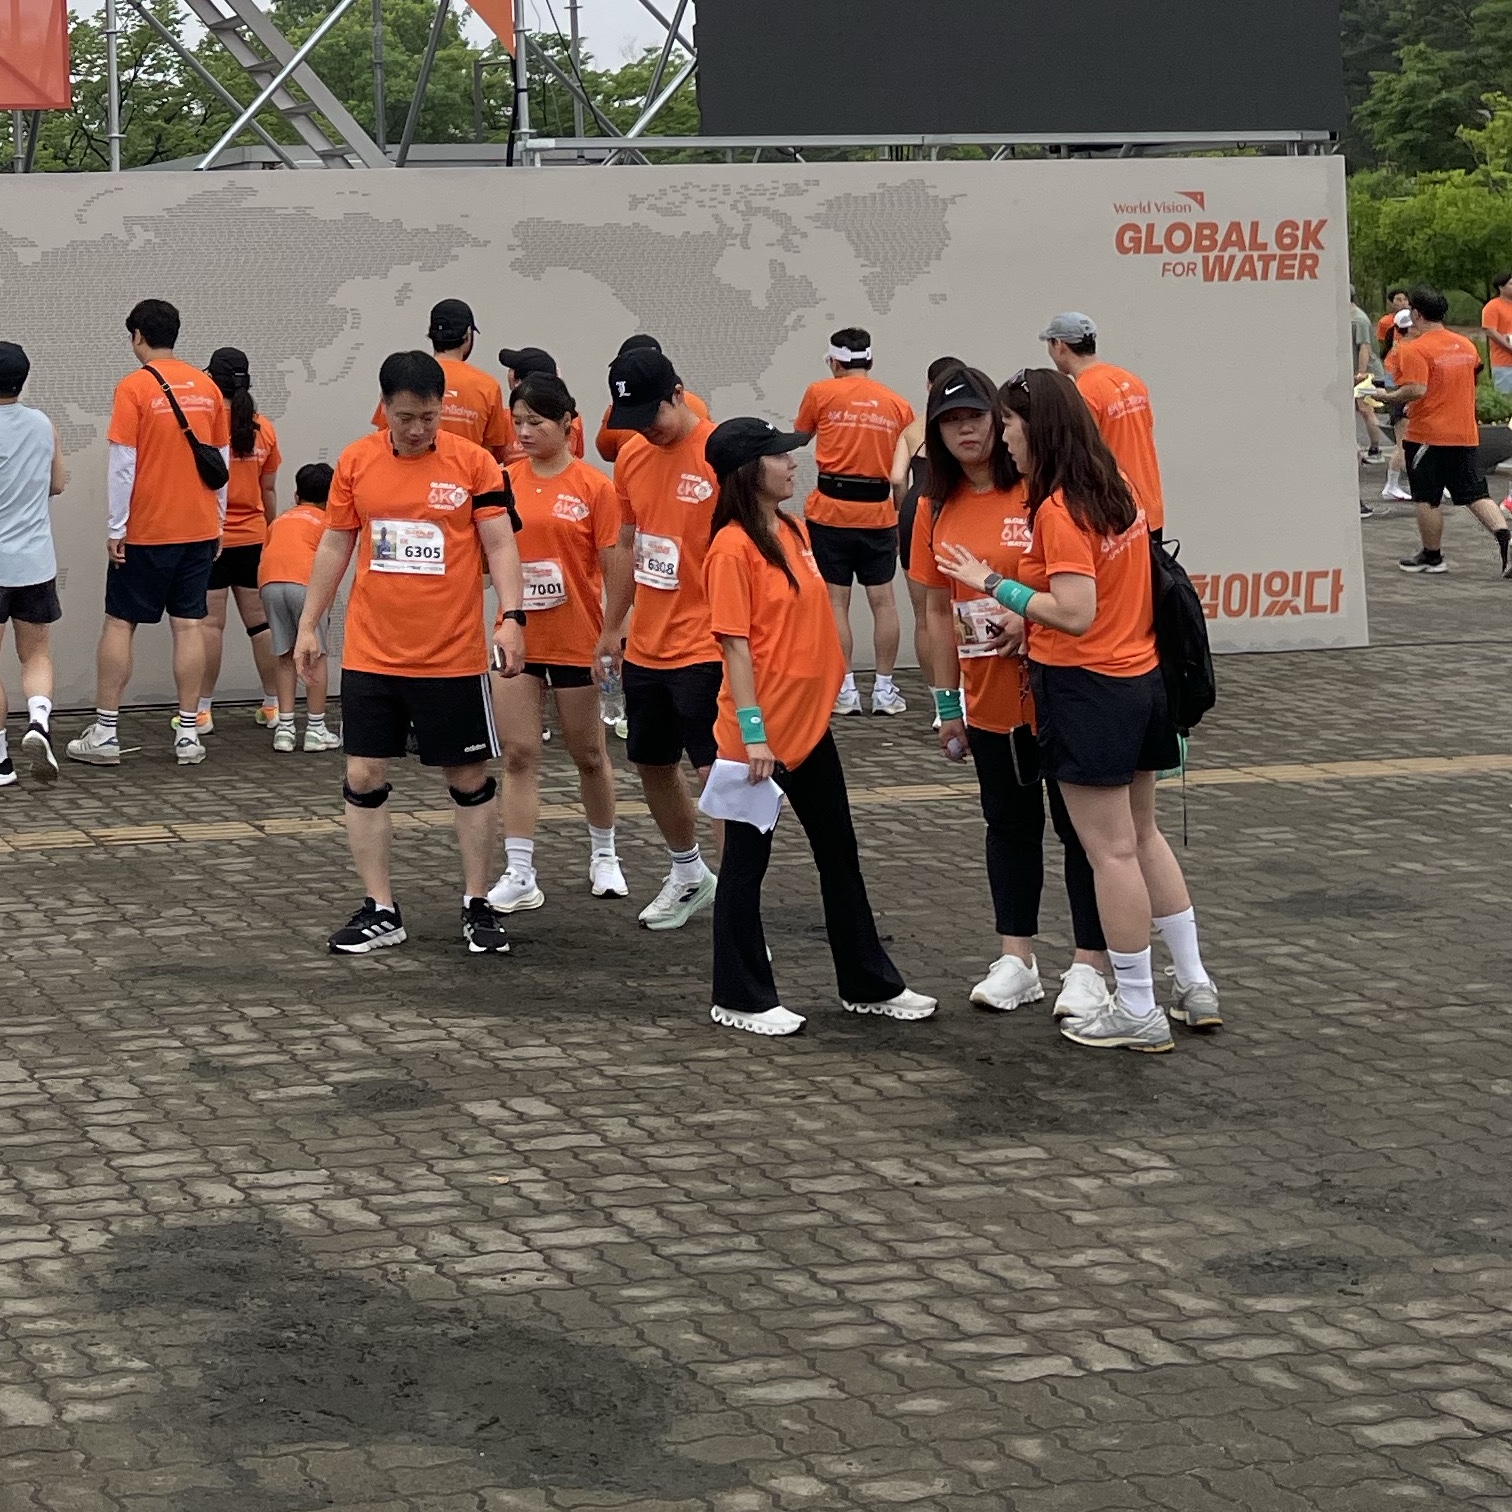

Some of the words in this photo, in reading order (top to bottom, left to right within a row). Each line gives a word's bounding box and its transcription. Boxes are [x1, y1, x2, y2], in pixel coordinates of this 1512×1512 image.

[1113, 200, 1152, 214] World
[1154, 200, 1192, 214] Vision
[1114, 220, 1269, 255] GLOBAL
[1274, 218, 1328, 251] 6K
[1161, 261, 1198, 278] FOR
[1201, 252, 1320, 282] WATER
[428, 488, 456, 506] 6K
[1001, 524, 1029, 541] 6K
[404, 545, 441, 559] 6305
[648, 558, 675, 575] 6308
[529, 582, 562, 595] 7001
